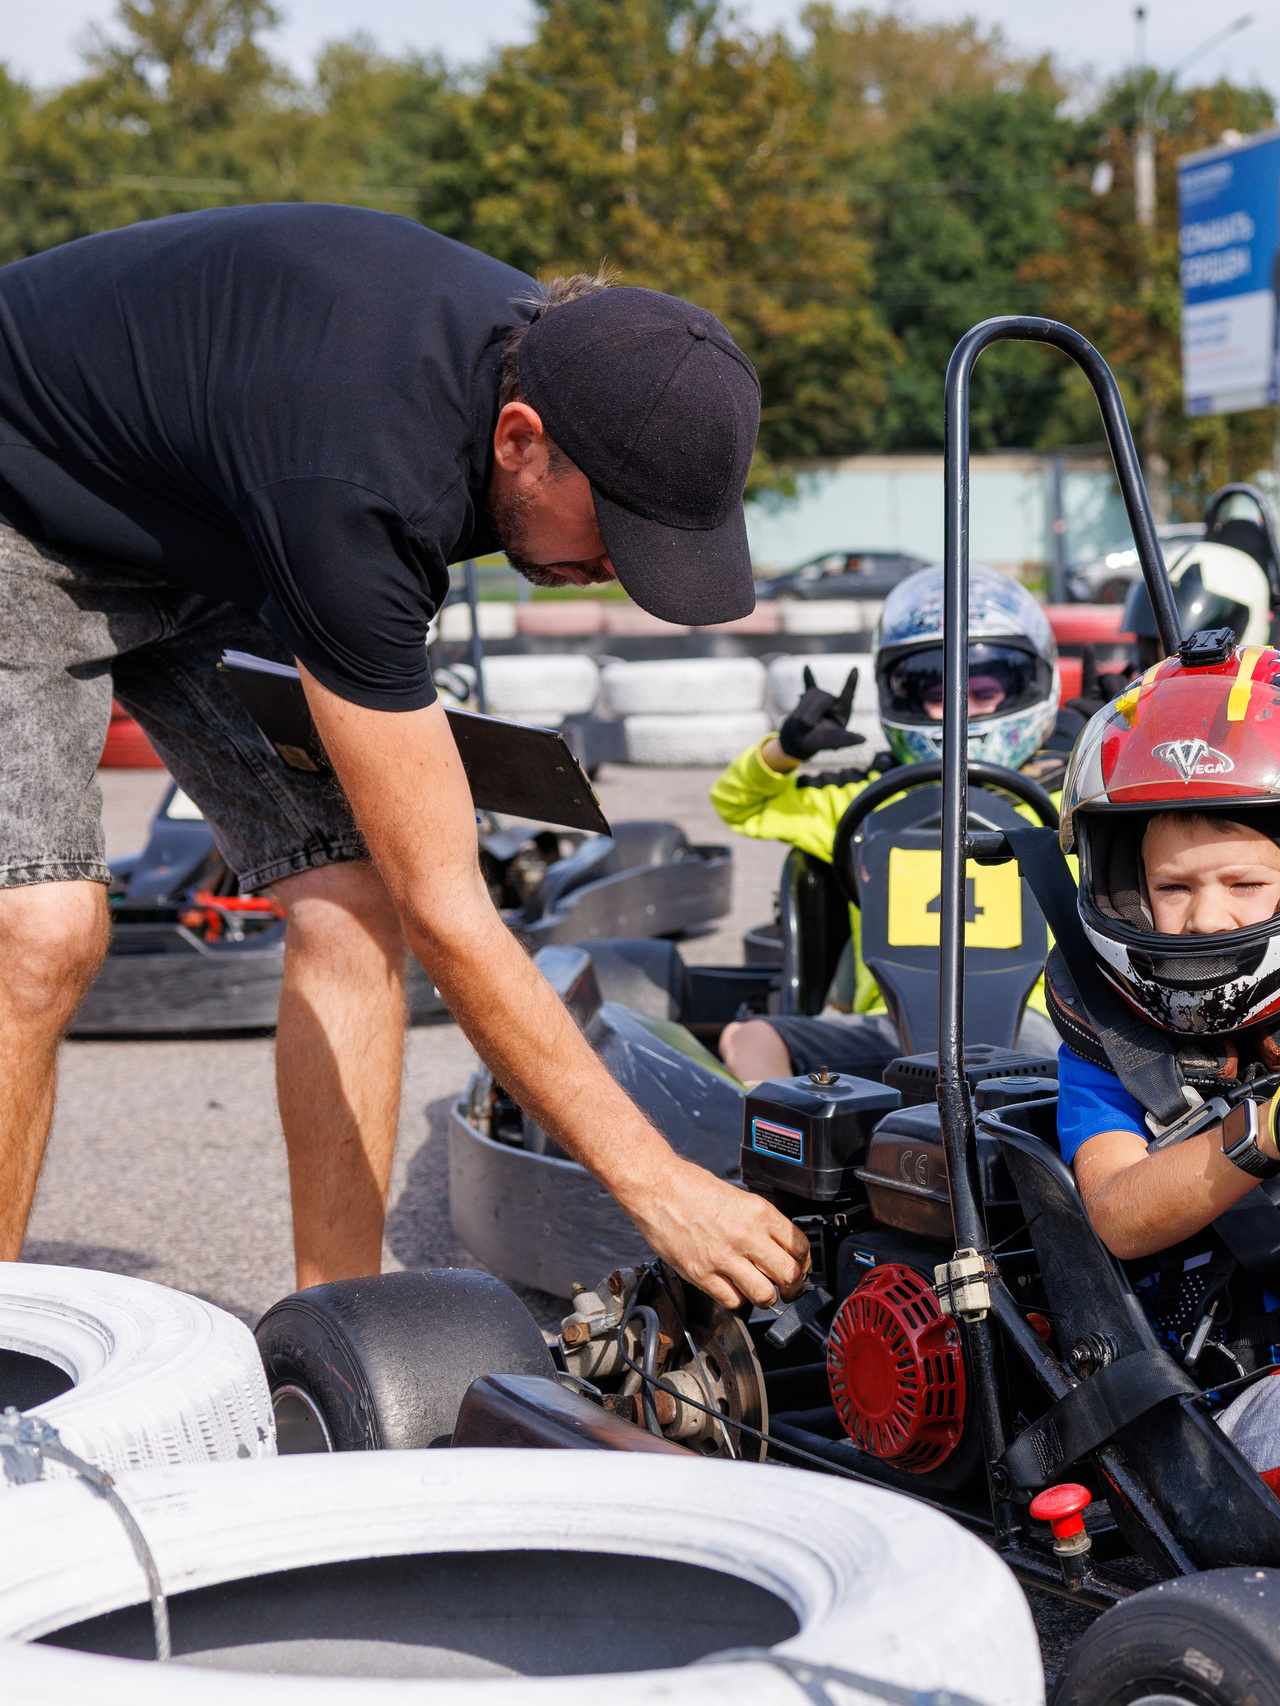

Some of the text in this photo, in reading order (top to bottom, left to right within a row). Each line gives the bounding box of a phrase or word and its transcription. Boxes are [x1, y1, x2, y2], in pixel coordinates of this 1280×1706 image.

[1186, 764, 1225, 775] VEGA
[926, 877, 984, 923] 4
[900, 1151, 928, 1185] CE
